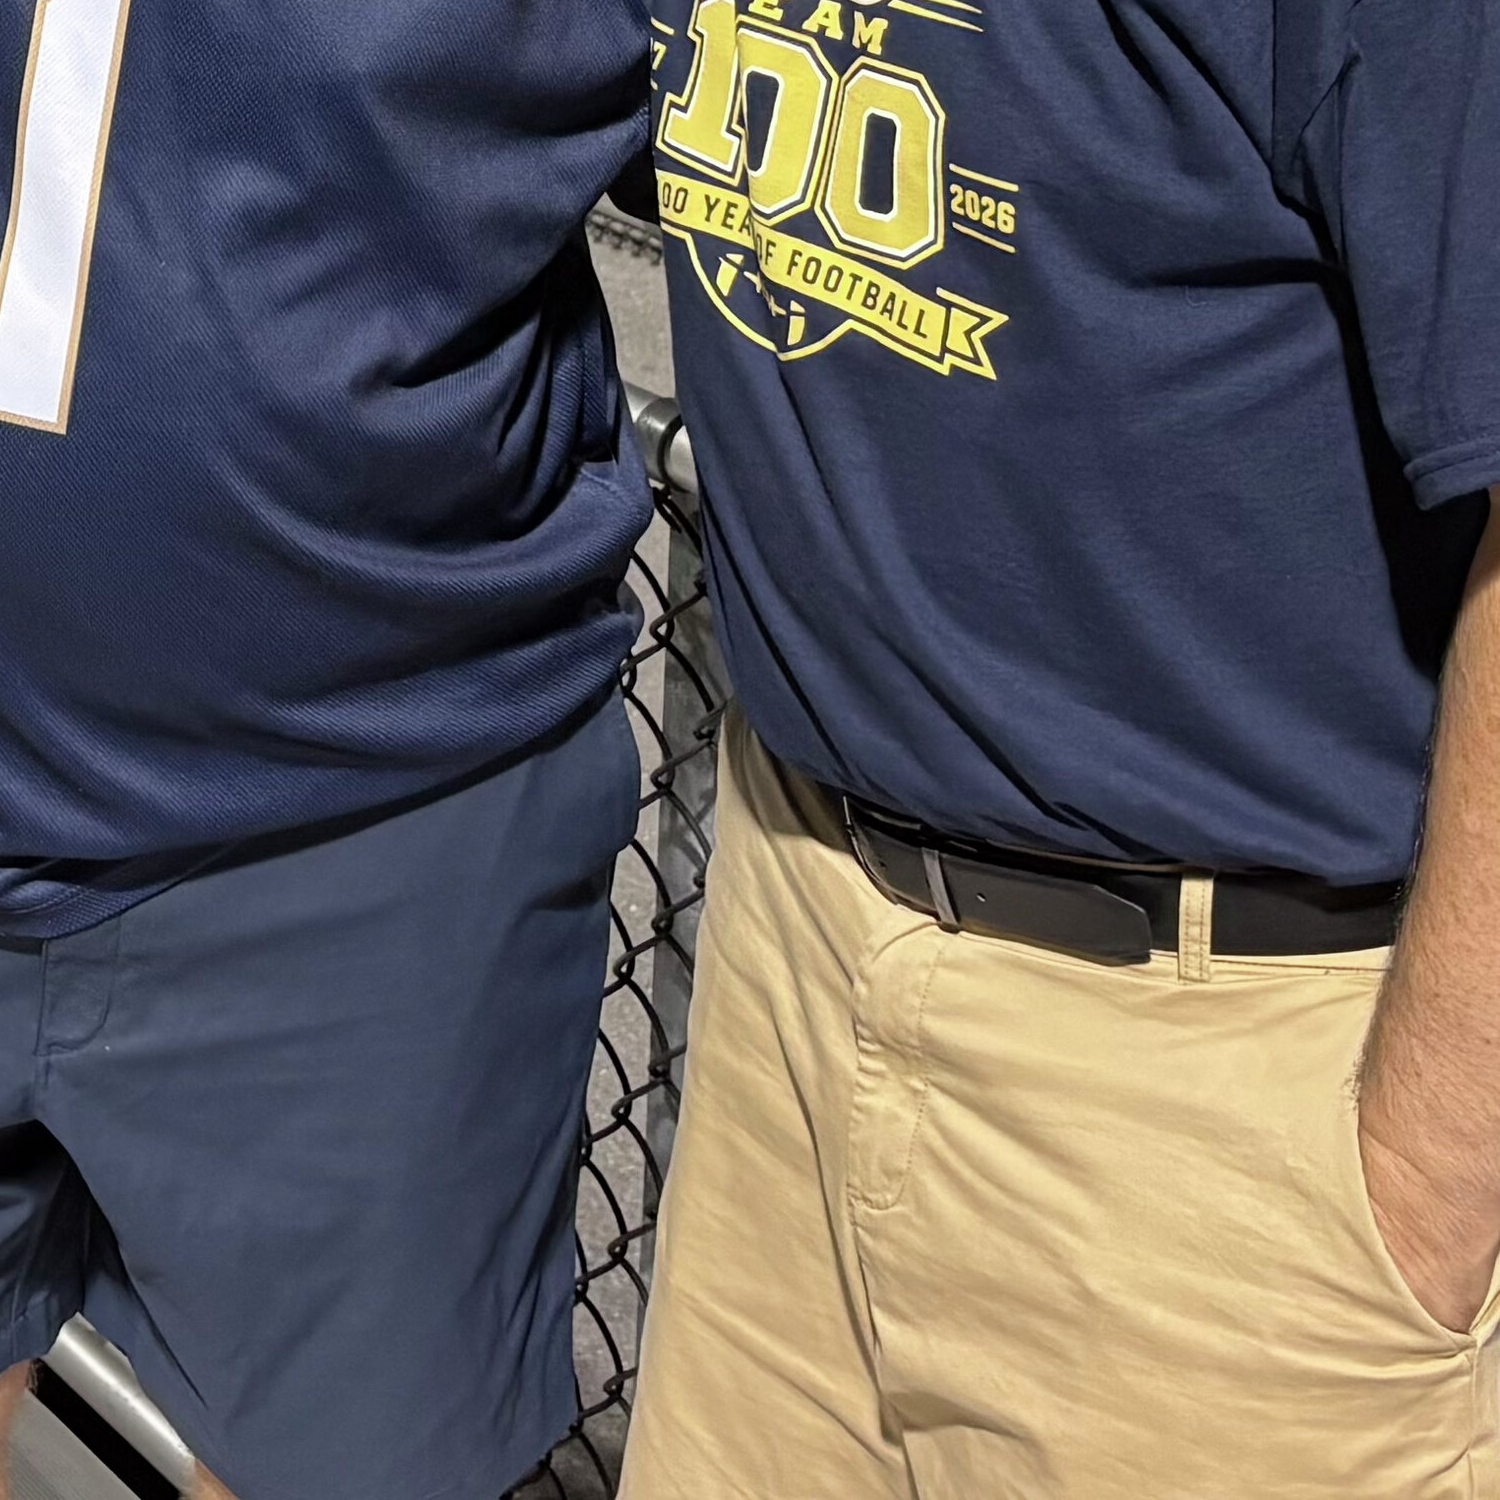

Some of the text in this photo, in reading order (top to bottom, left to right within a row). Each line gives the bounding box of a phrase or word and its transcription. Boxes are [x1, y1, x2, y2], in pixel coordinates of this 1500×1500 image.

[661, 181, 689, 214] 00
[704, 193, 751, 237] YEA
[786, 249, 928, 339] FOOTBALL
[949, 183, 1016, 234] 2026
